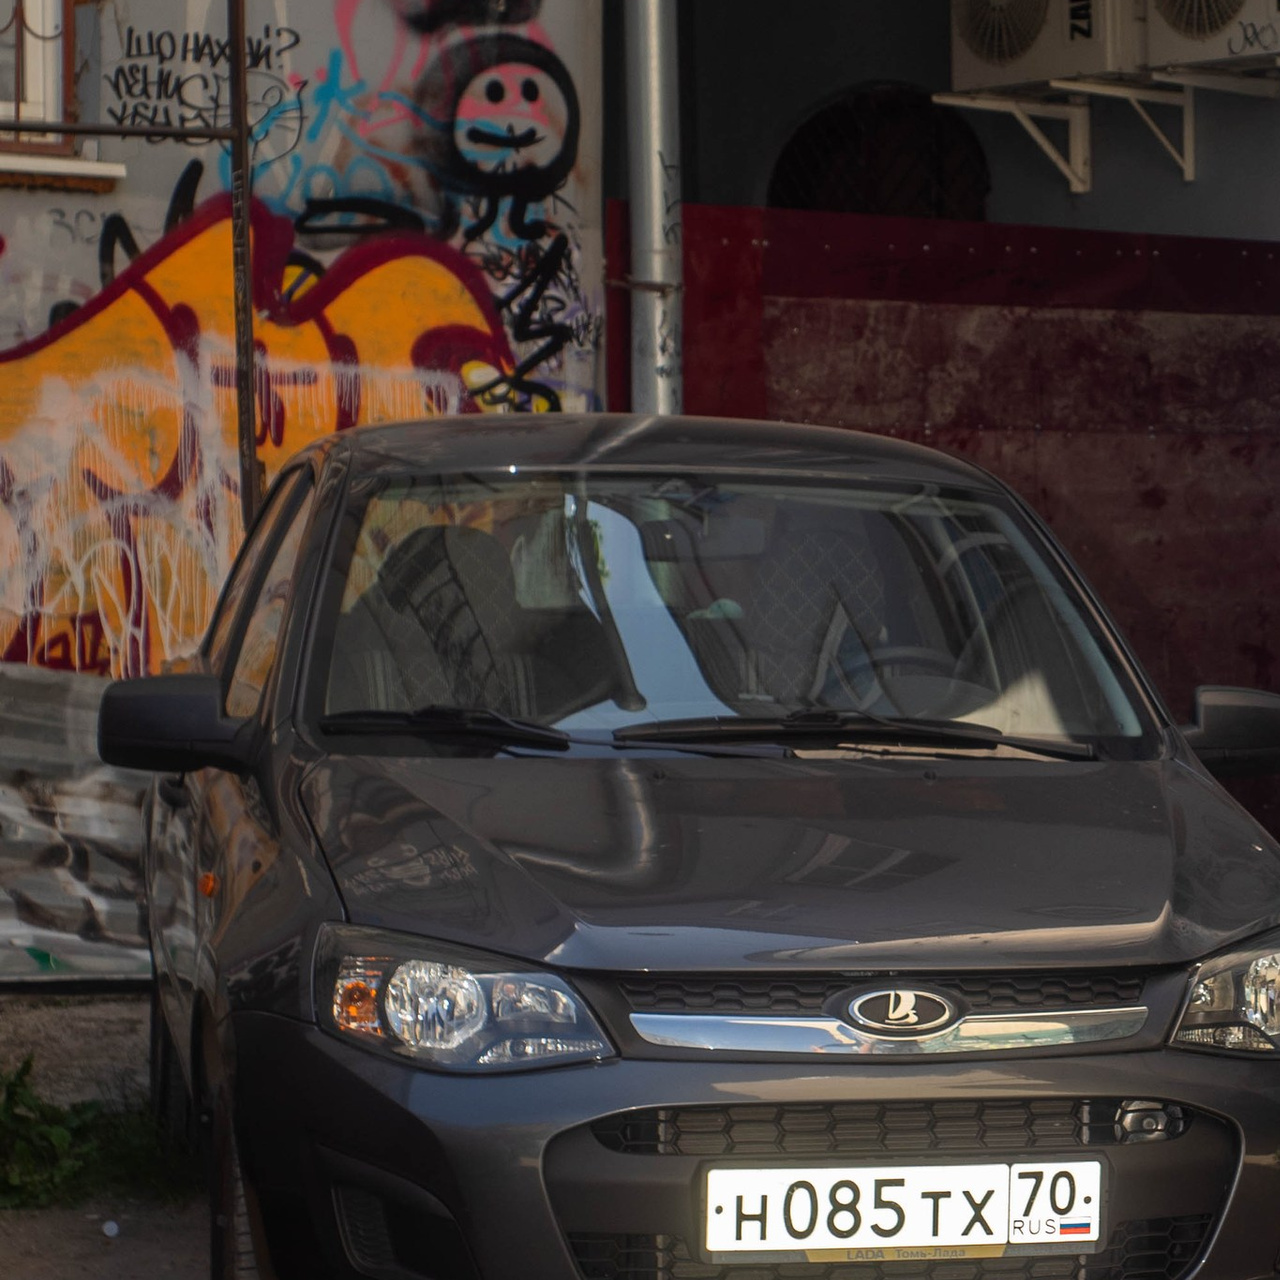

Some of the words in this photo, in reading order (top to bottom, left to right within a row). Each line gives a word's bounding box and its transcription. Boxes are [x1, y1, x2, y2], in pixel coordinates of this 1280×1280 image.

[1017, 1170, 1076, 1218] 70
[1012, 1218, 1056, 1236] RUS
[846, 1248, 885, 1261] LADA
[895, 1247, 966, 1260] Томь-Лада
